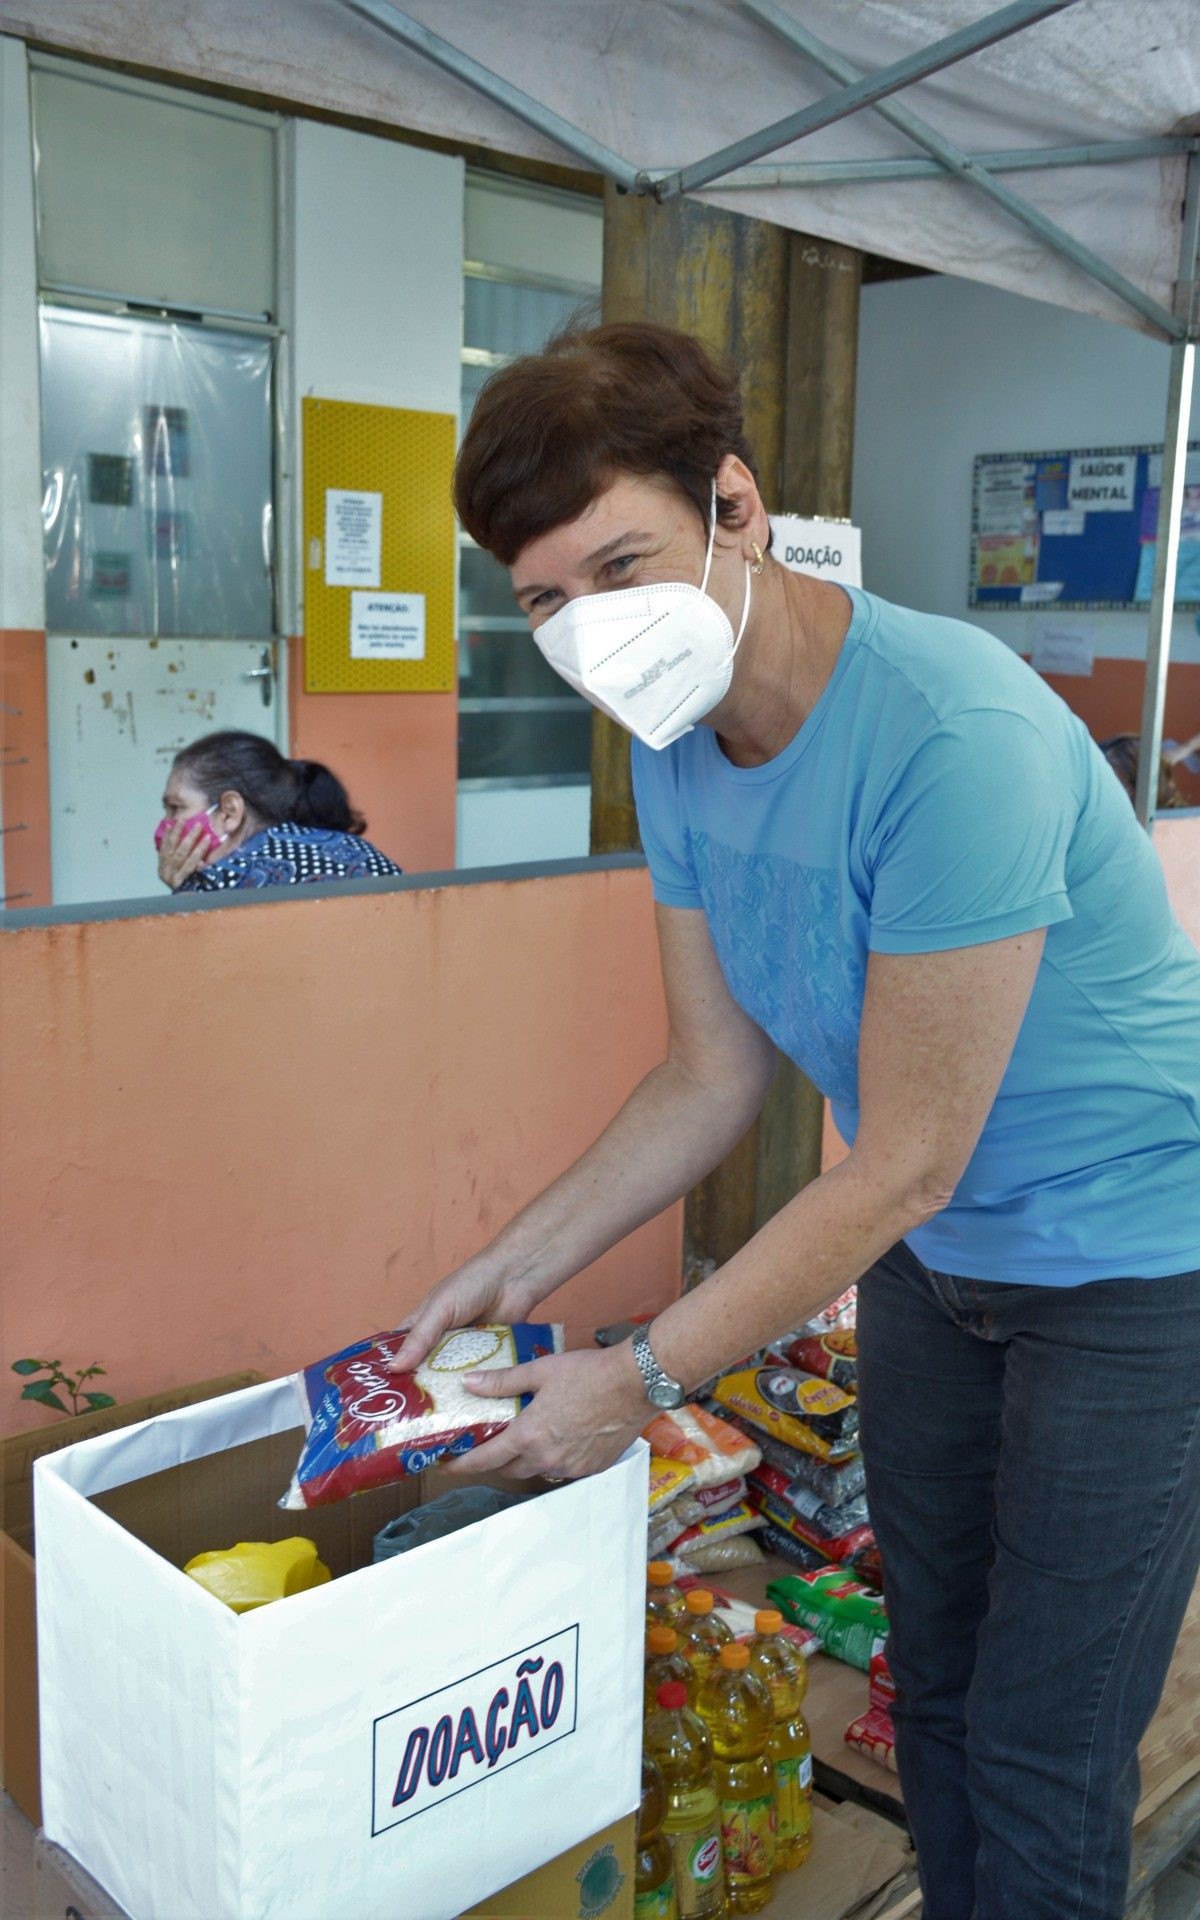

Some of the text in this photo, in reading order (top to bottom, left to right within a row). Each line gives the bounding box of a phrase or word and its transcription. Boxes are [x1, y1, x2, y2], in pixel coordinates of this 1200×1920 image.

[1080, 460, 1124, 477] SAÚDE
[1071, 486, 1127, 500] MENTAL
[785, 545, 842, 569] DOAÇÃO
[346, 1361, 406, 1422] Ouro
[392, 1655, 564, 1808] DOAÇÃO
